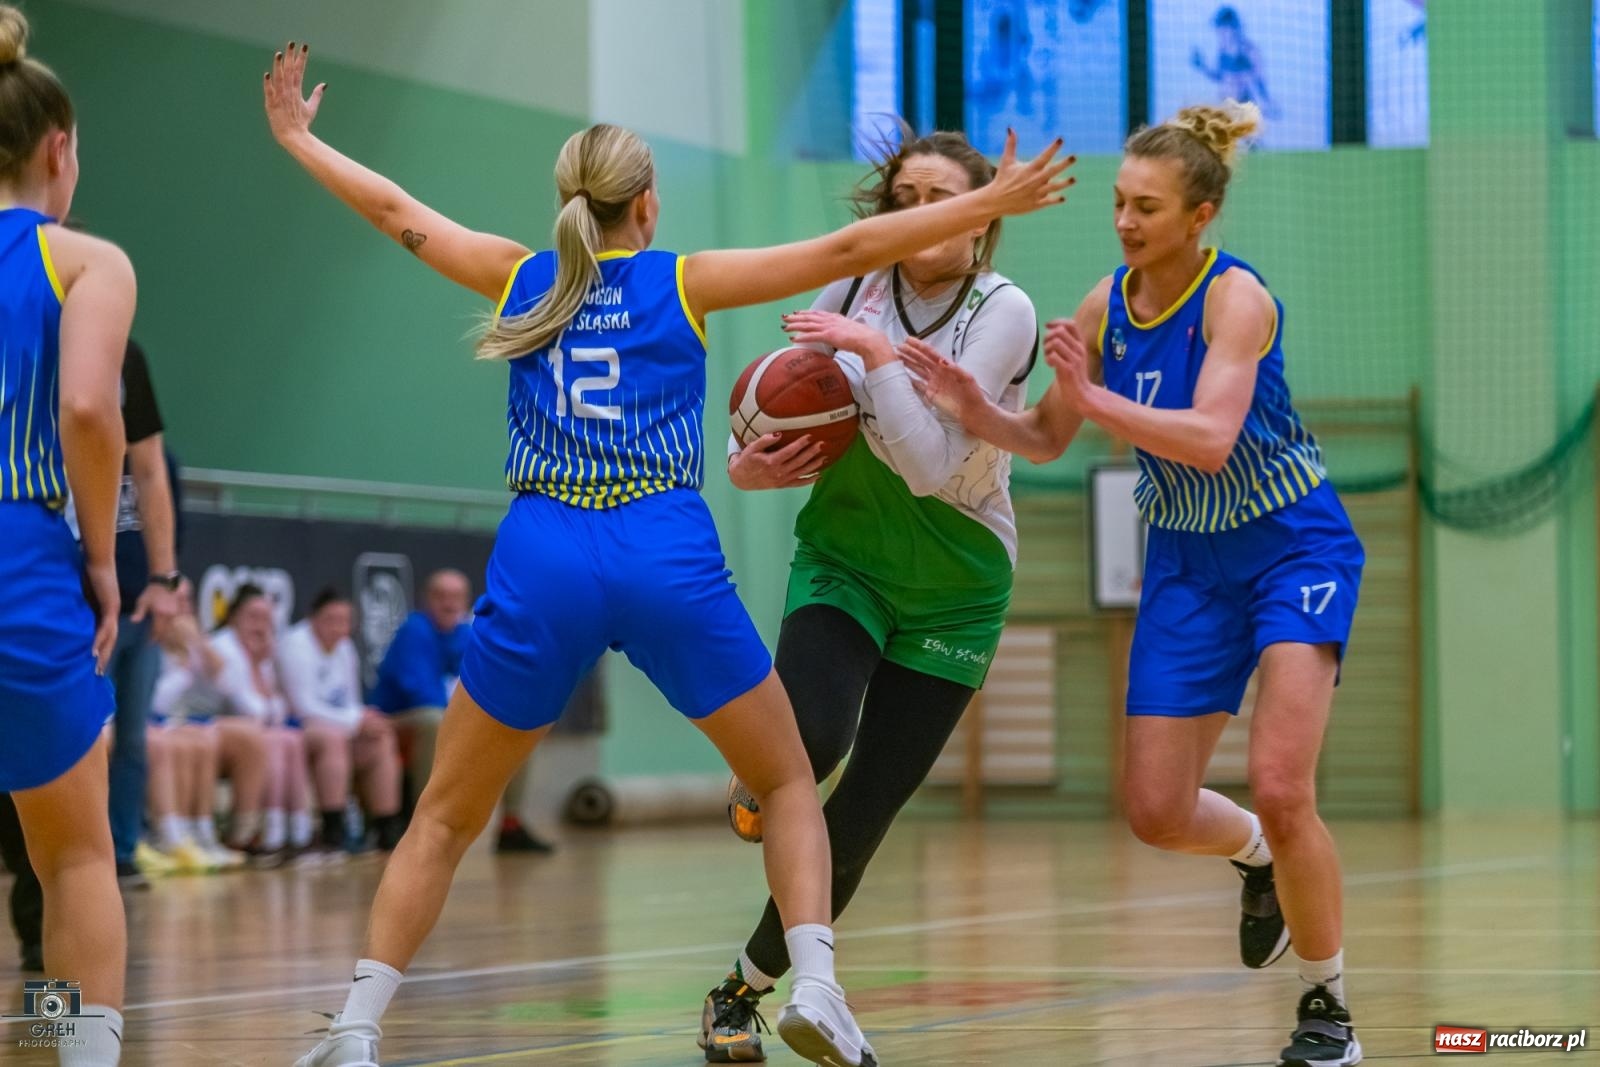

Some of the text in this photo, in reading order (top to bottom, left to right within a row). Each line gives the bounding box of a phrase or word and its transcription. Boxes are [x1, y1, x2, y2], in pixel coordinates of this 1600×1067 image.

[582, 286, 623, 305] OGON
[548, 347, 621, 420] 12
[1135, 370, 1162, 408] 17
[1300, 581, 1337, 615] 17
